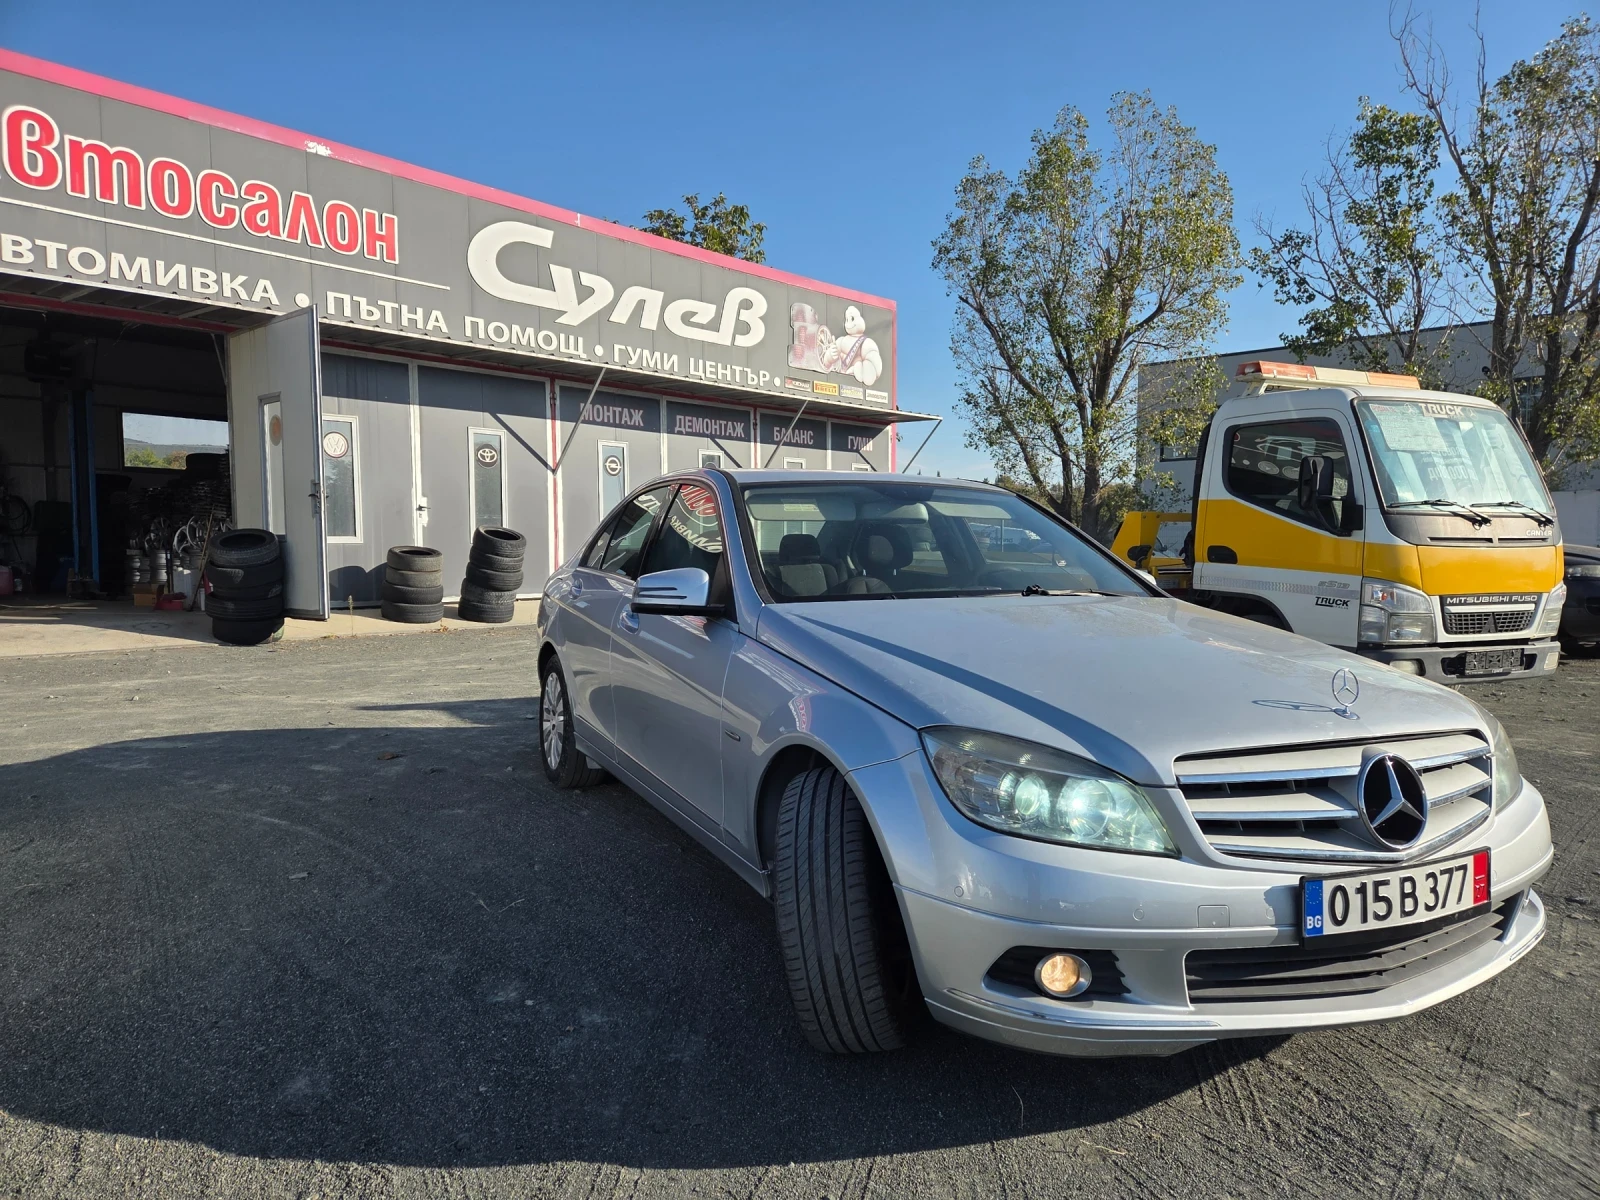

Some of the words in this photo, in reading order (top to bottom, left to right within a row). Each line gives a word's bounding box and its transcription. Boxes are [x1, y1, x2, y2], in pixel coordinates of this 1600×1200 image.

[0, 105, 399, 265] втосалон
[466, 221, 768, 347] Сулев
[0, 233, 281, 306] ВТОМИВКА
[326, 291, 449, 334] ПЪТНА
[463, 316, 587, 359] ПОМОЩ
[613, 344, 679, 372] ГУМИ
[689, 357, 771, 388] ЦЕНТЪР
[580, 404, 644, 427] МОНТАЖ
[1418, 403, 1464, 418] TRUCK
[674, 415, 745, 439] ДЕМОНТАЖ
[773, 426, 814, 446] БАЛАНС
[848, 435, 873, 452] ГУМИ
[1526, 529, 1553, 537] CANTER
[1314, 596, 1351, 609] TRUCK
[1446, 595, 1509, 604] MITSUBISHI
[1306, 915, 1322, 930] BG
